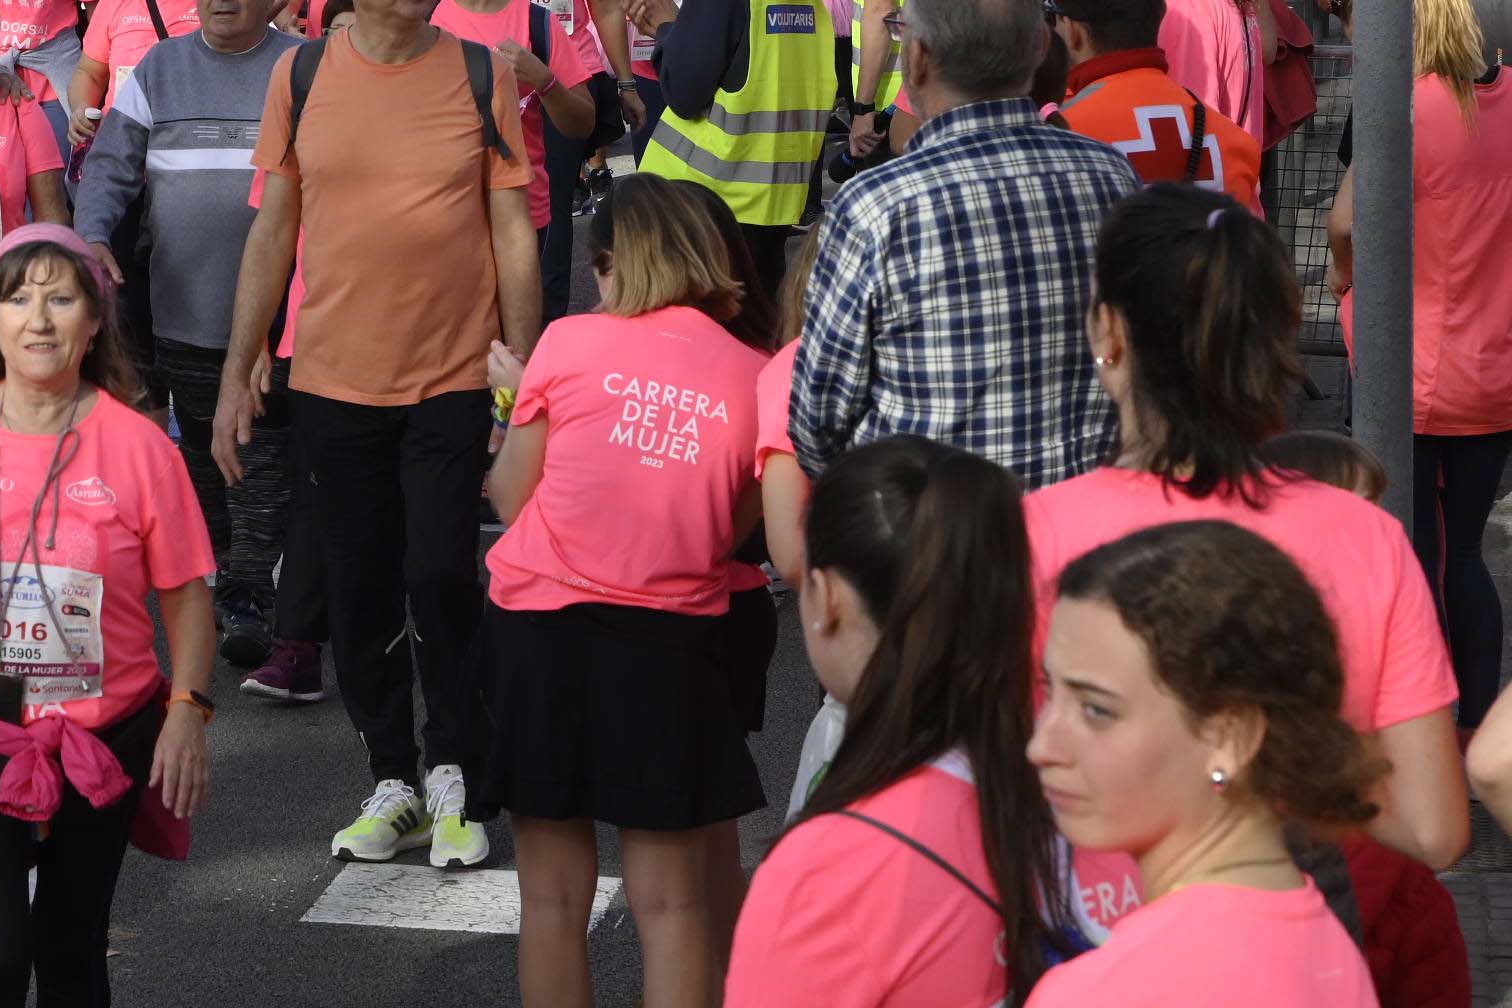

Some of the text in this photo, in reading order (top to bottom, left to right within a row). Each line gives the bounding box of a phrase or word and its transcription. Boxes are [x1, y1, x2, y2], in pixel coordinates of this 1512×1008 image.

[0, 20, 49, 35] DORSAL
[603, 373, 729, 424] CARRERA
[621, 399, 700, 438] DE LA
[607, 421, 701, 465] MUJER
[639, 455, 664, 469] 2023
[61, 587, 90, 599] SUMA
[1, 620, 48, 641] 016
[0, 646, 42, 660] 15905
[4, 665, 63, 675] DE LA MUJER
[41, 683, 82, 695] Santand
